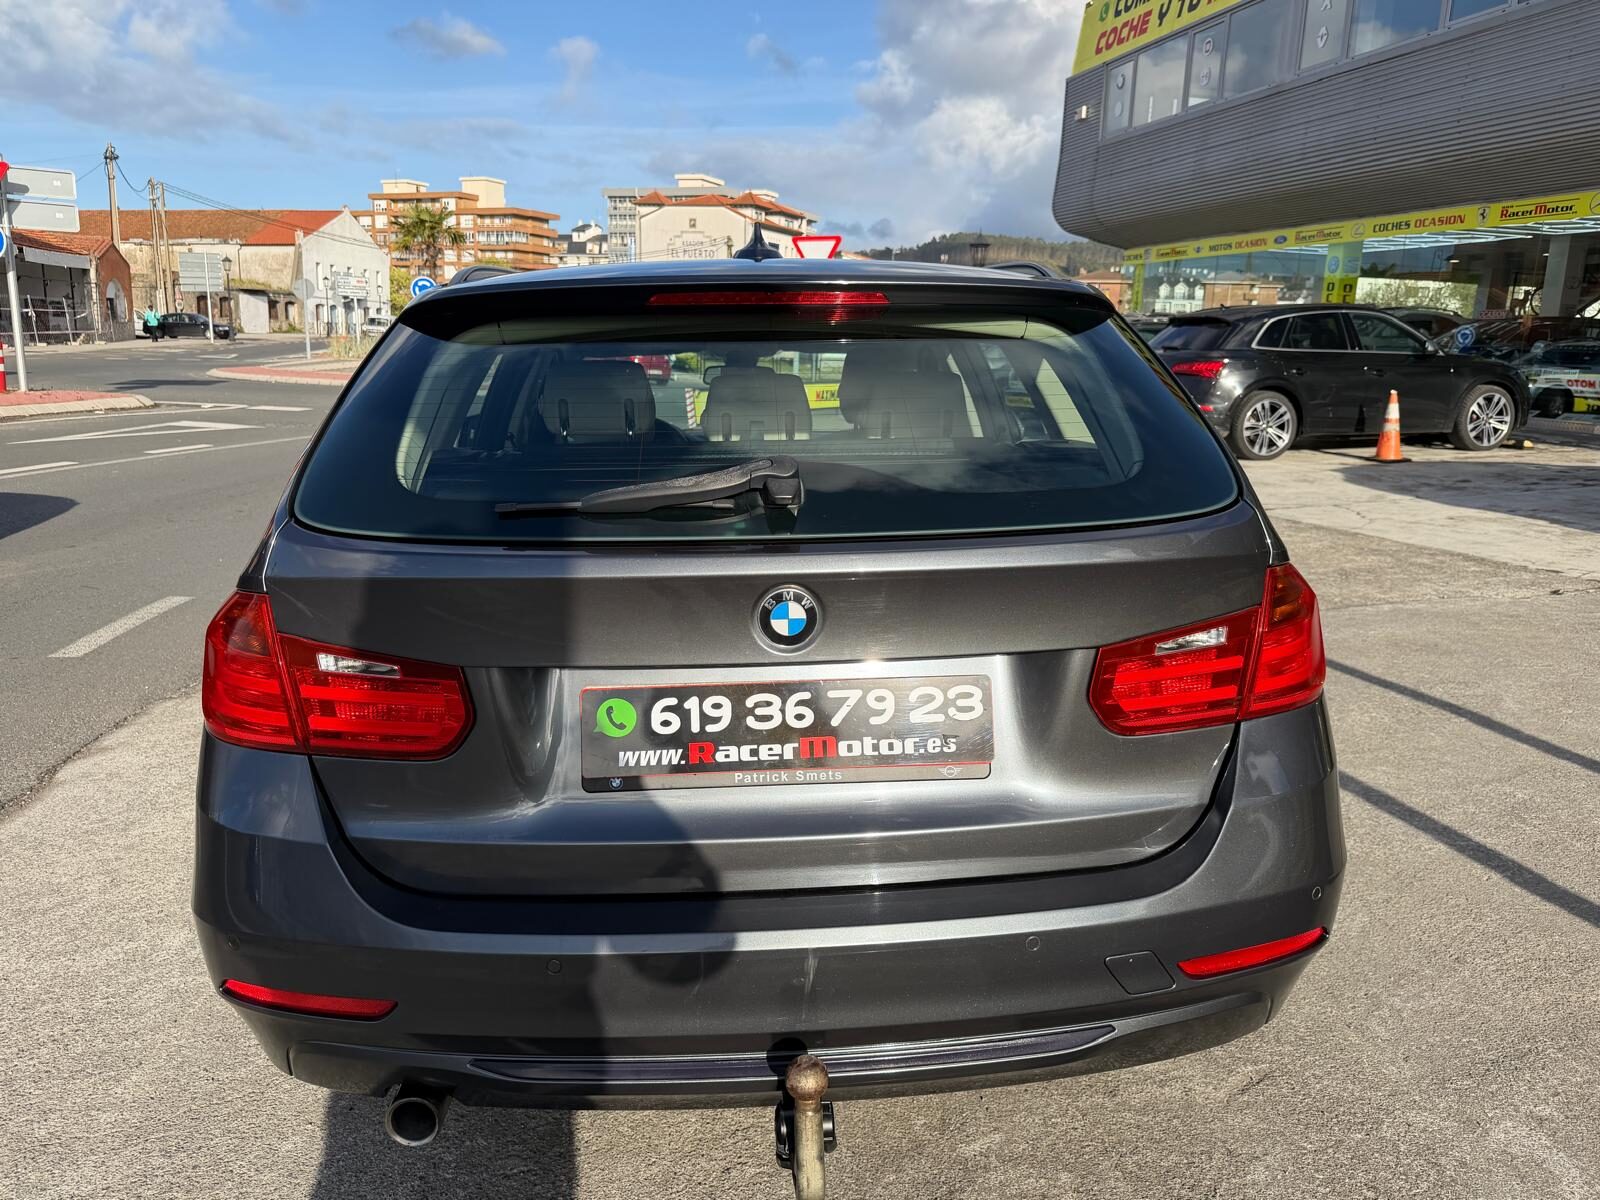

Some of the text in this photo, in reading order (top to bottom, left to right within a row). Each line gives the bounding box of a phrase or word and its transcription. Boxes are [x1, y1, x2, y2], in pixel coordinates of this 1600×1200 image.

[1094, 8, 1153, 56] COCHE
[1157, 0, 1172, 27] Y
[1372, 213, 1467, 233] COCHES OCASION
[1208, 238, 1268, 252] MOTOS OCASION
[764, 591, 813, 610] BMW
[650, 685, 984, 735] 619 36 79 23
[618, 735, 957, 767] www.RacerMotor.es
[735, 770, 842, 783] Patrick Smets
